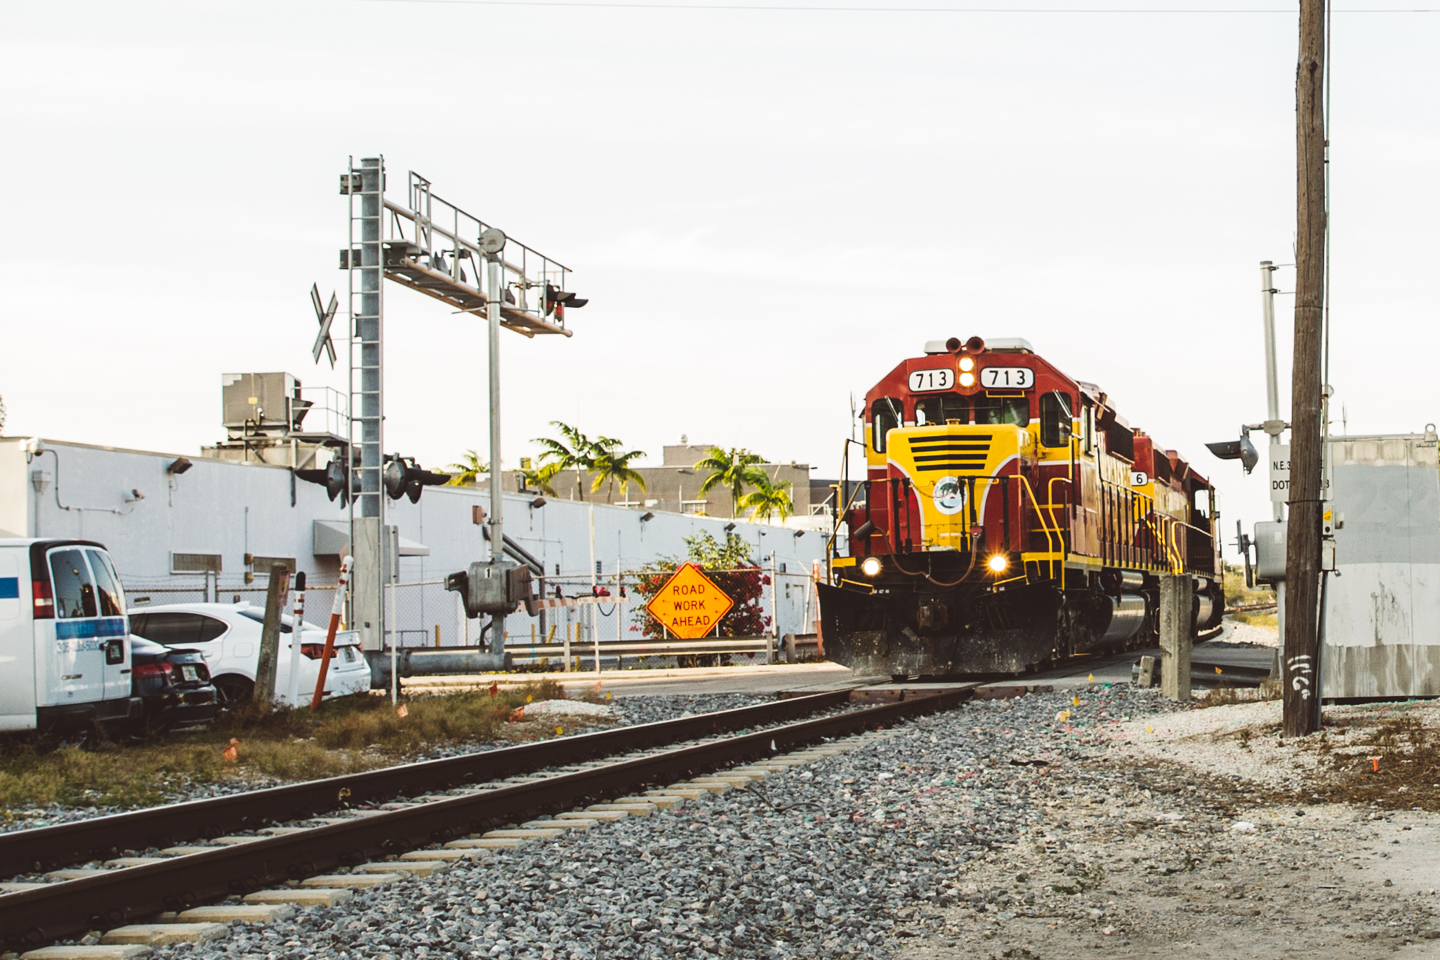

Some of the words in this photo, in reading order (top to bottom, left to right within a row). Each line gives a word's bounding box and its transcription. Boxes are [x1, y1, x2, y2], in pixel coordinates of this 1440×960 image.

[916, 371, 947, 388] 713
[989, 370, 1025, 386] 713
[1272, 480, 1290, 490] DOT
[673, 584, 705, 596] ROAD
[674, 600, 706, 611] WORK
[672, 615, 711, 627] AHEAD
